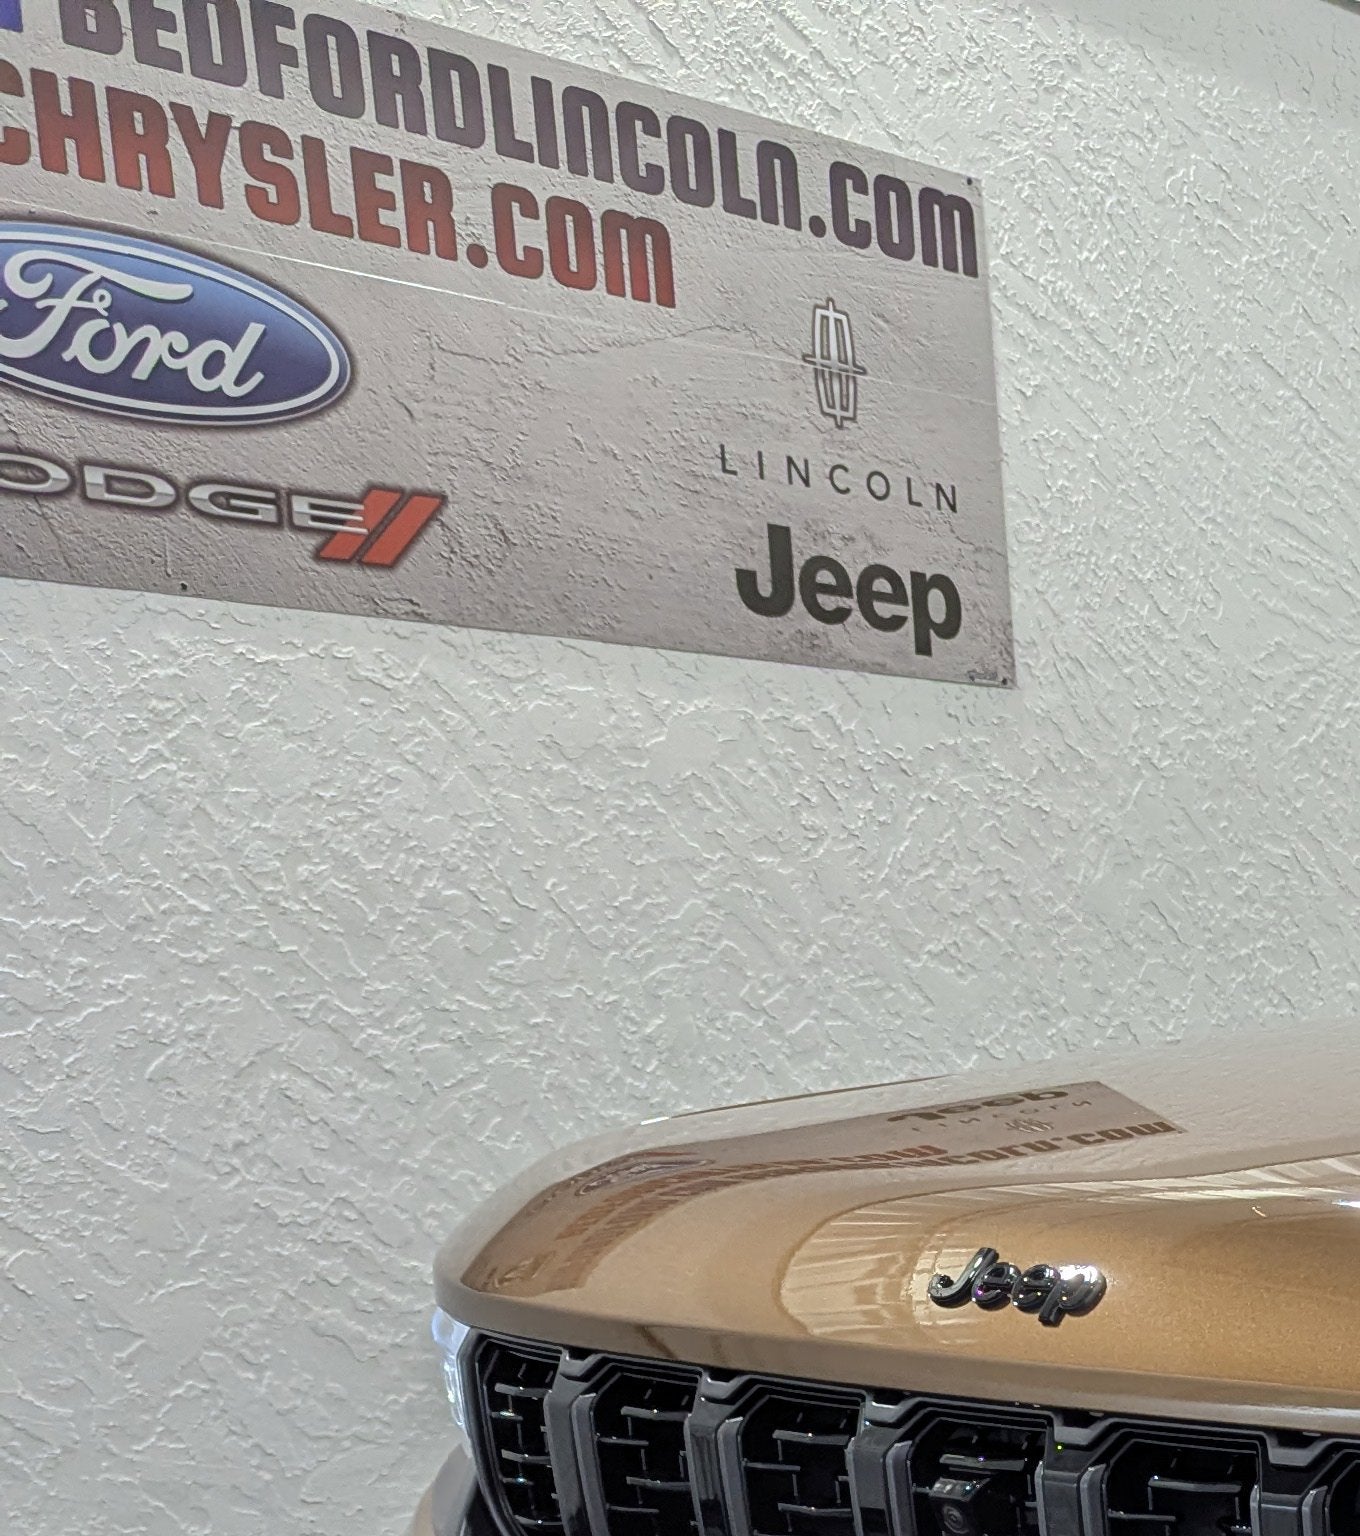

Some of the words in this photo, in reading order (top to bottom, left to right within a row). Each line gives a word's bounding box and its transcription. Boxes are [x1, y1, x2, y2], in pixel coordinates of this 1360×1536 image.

[0, 249, 267, 398] Ford
[719, 443, 959, 513] LINCOLN
[734, 523, 962, 657] Jeep
[927, 1246, 1108, 1328] Jeep
